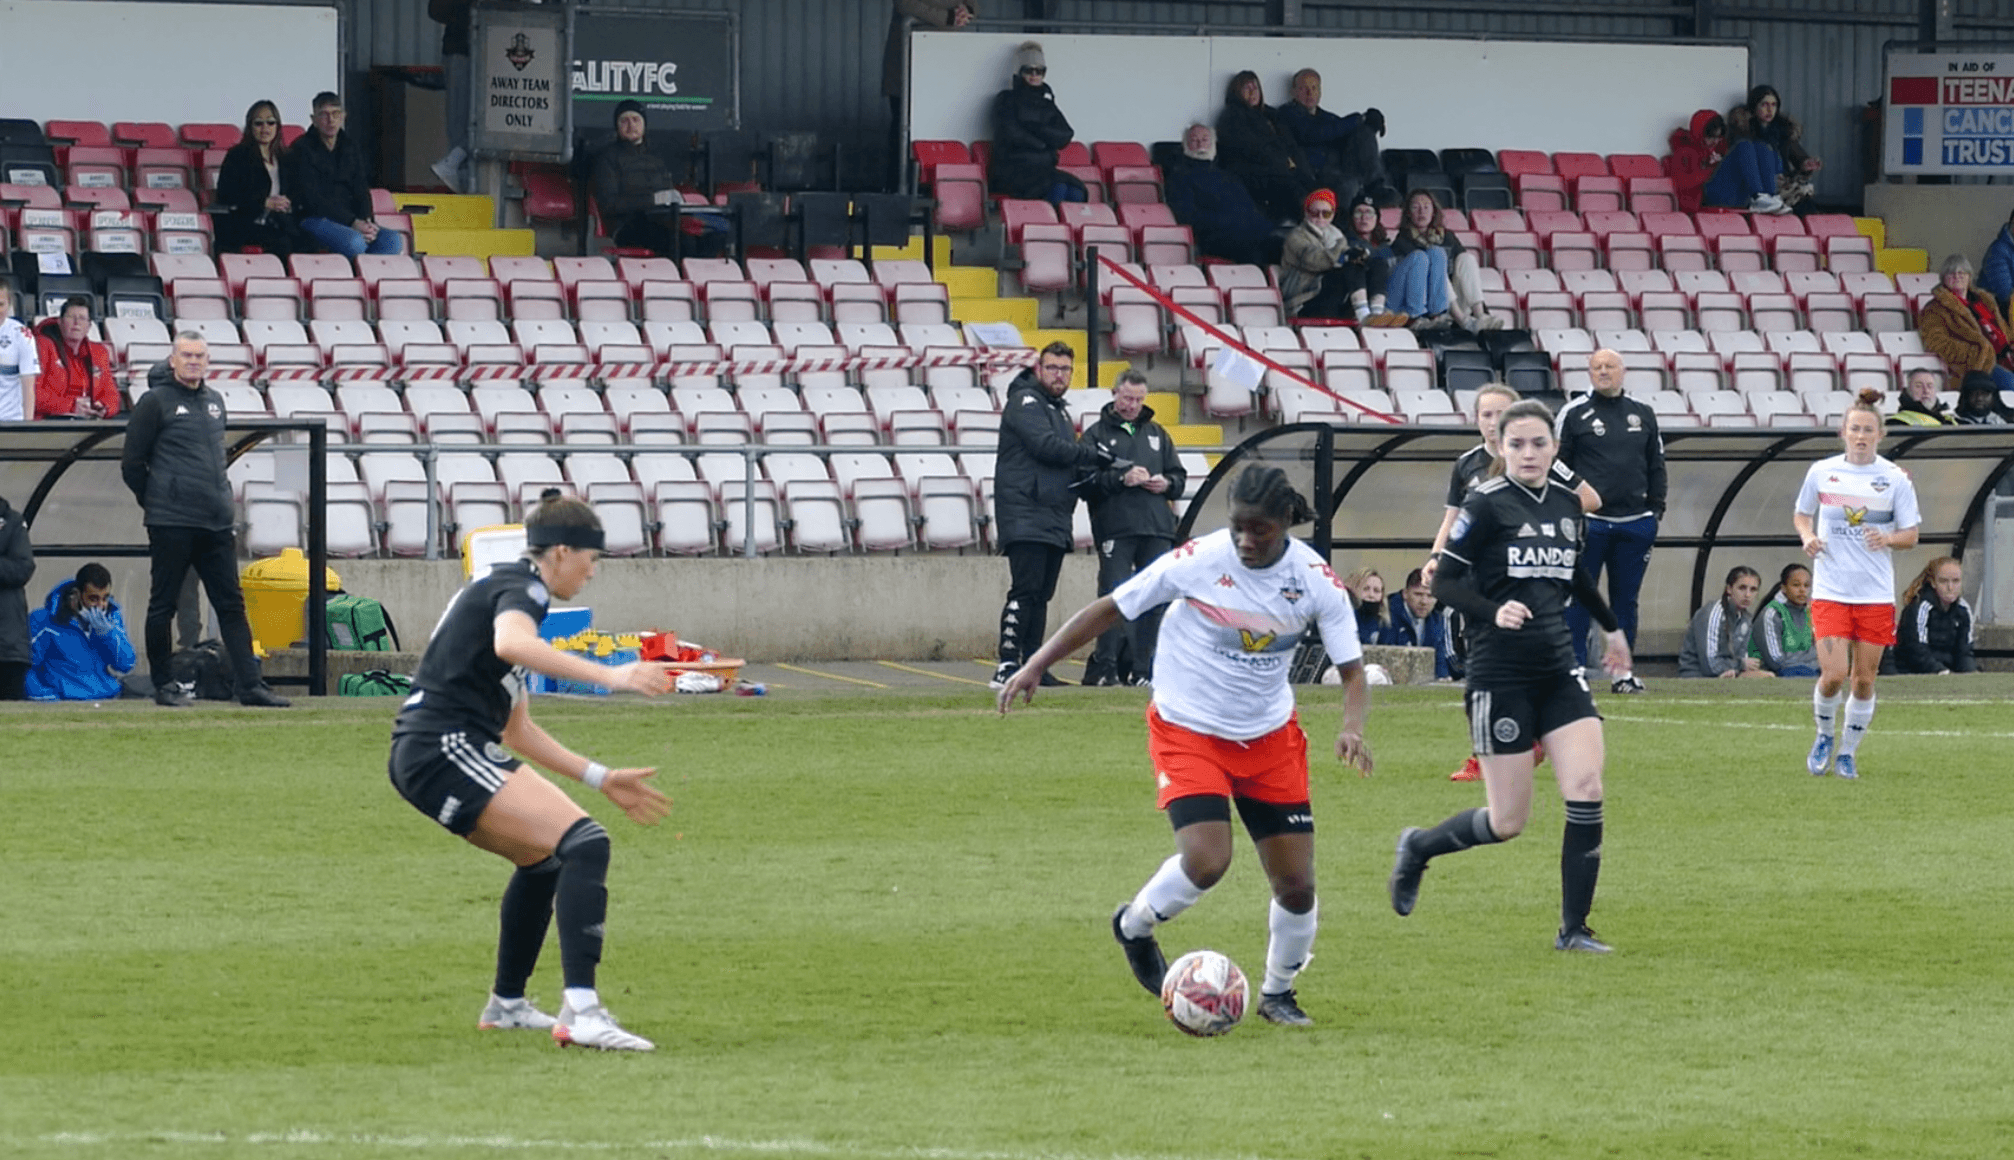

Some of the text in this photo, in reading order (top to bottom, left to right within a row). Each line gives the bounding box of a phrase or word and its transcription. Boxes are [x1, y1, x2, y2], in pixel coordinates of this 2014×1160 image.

[1948, 62, 1995, 71] IN AID OF
[491, 77, 550, 92] AWAY TEAM
[491, 94, 549, 110] DIRECTORS
[505, 113, 533, 127] ONLY
[1944, 109, 2014, 133] CANC
[1944, 139, 2014, 164] TRUST
